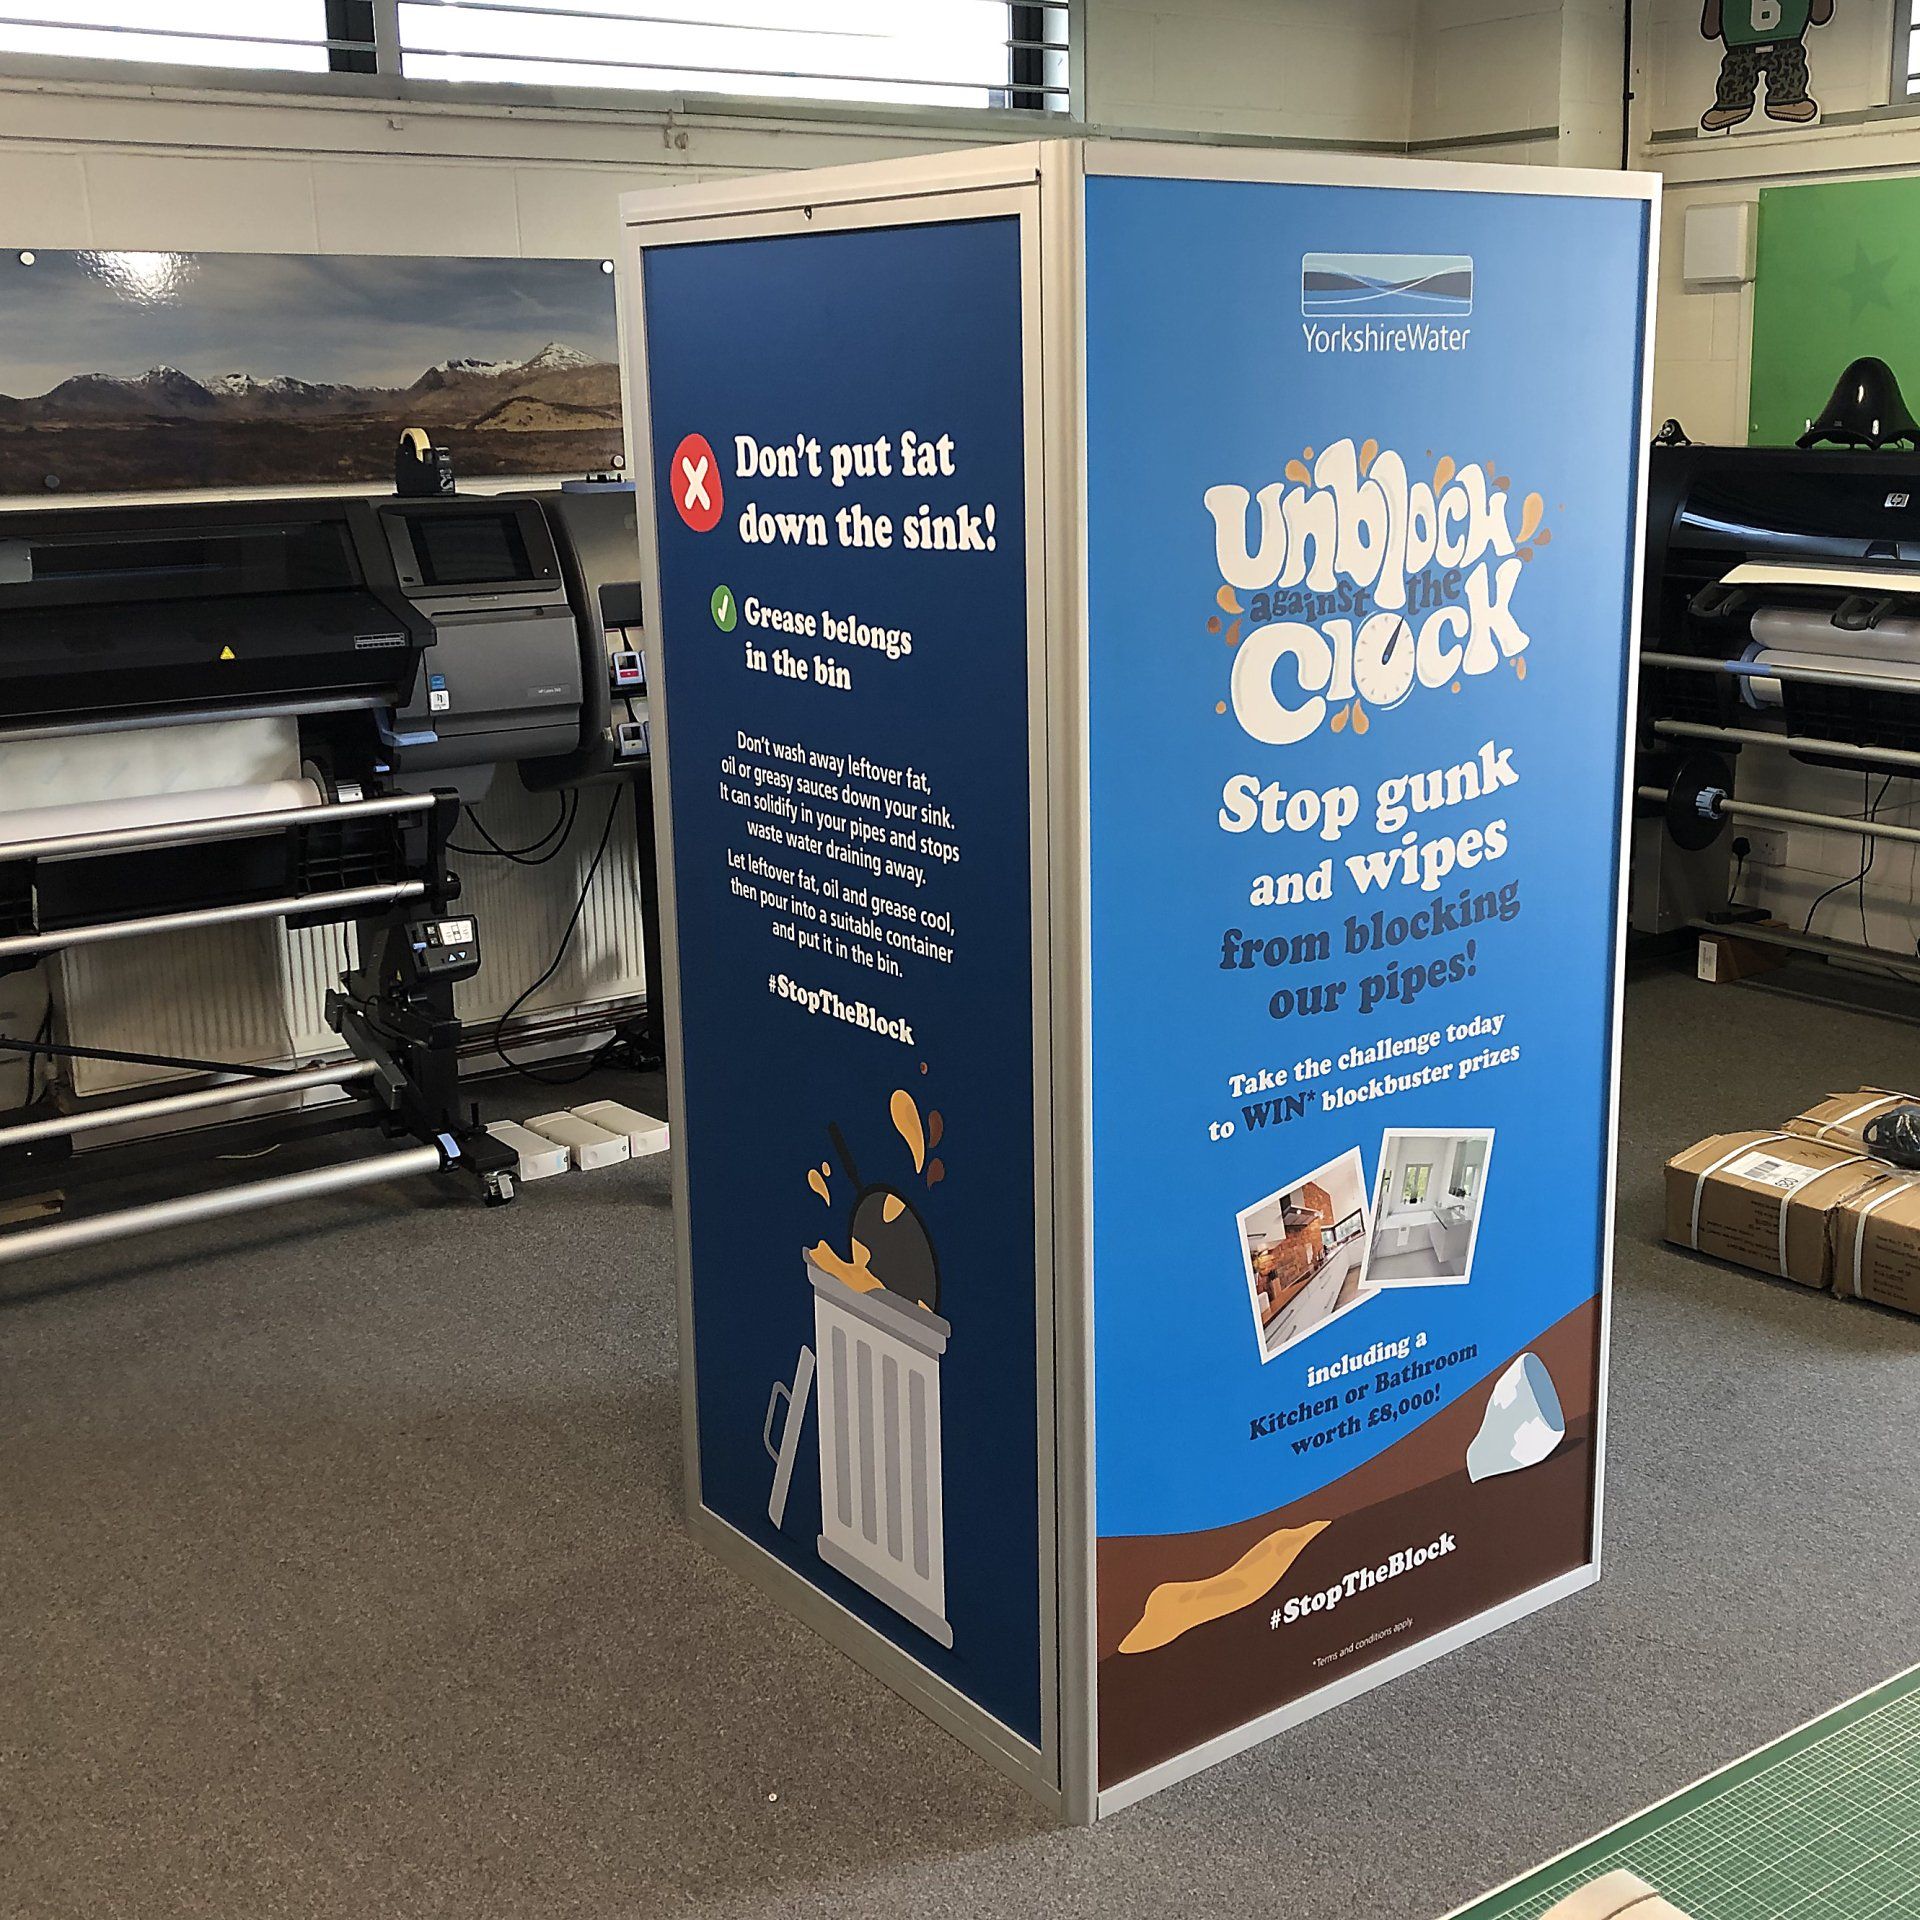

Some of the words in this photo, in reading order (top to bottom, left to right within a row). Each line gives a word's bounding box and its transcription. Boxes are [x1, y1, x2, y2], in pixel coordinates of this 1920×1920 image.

[1750, 0, 1781, 31] 6
[1302, 323, 1471, 353] YorkshireWater
[734, 433, 822, 477] Don't
[830, 436, 892, 487] put
[901, 430, 955, 477] fat
[739, 503, 828, 546] down
[836, 504, 892, 548] the
[903, 503, 996, 551] sink!
[744, 597, 816, 636] Grease
[822, 611, 912, 660] belongs
[1250, 580, 1371, 623] against
[1404, 569, 1462, 615] the
[745, 642, 767, 671] in
[772, 649, 808, 680] the
[813, 655, 852, 690] bin
[721, 755, 736, 774] oil
[738, 762, 751, 778] or
[754, 768, 793, 793] greasy
[796, 777, 838, 800] sauces
[842, 784, 880, 812] down
[884, 797, 917, 819] your
[921, 804, 955, 829] sink.
[737, 730, 770, 755] Don't
[773, 743, 805, 764] wash
[809, 752, 844, 777] away
[848, 754, 902, 785] leftover
[906, 767, 931, 795] fat,
[1218, 774, 1359, 841] Stop
[1376, 740, 1520, 834] gunk
[719, 782, 729, 800] It
[731, 788, 751, 806] can
[754, 793, 798, 823] solidify
[801, 802, 813, 822] in
[816, 810, 847, 832] your
[850, 817, 886, 844] pipes
[890, 830, 916, 851] and
[920, 836, 960, 864] stops
[747, 820, 783, 843] waste
[786, 831, 823, 855] water
[826, 839, 881, 875] draining
[885, 859, 926, 888] away.
[728, 848, 745, 871] Let
[748, 852, 795, 884] leftover
[797, 868, 819, 895] fat,
[823, 878, 838, 899] oil
[843, 886, 867, 908] and
[871, 895, 916, 922] grease
[920, 910, 955, 936] cool,
[1249, 858, 1333, 907] and
[1345, 819, 1508, 893] wipes
[731, 876, 757, 900] then
[760, 887, 788, 912] pour
[791, 895, 816, 919] into
[820, 908, 827, 923] a
[831, 909, 882, 941] suitable
[886, 928, 953, 964] container
[772, 920, 795, 941] and
[798, 928, 820, 949] put
[823, 937, 832, 953] it
[836, 940, 848, 960] in
[851, 943, 874, 968] the
[877, 950, 903, 977] bin.
[1219, 928, 1331, 969] from
[1344, 880, 1520, 954] blocking
[768, 973, 914, 1045] #StopTheBlock
[1269, 979, 1347, 1019] our
[1359, 939, 1476, 1014] pipes!
[1228, 1068, 1288, 1097] Take
[1294, 1057, 1332, 1083] the
[1337, 1029, 1441, 1069] challenge
[1446, 1013, 1506, 1043] today
[1208, 1119, 1235, 1142] to
[1321, 1063, 1454, 1112] blockbuster
[1458, 1044, 1520, 1080] prizes
[1249, 1395, 1339, 1440] Kitchen
[1344, 1383, 1370, 1405] or
[1374, 1343, 1478, 1395] Bathroom
[1306, 1336, 1411, 1388] including
[1415, 1331, 1428, 1348] a
[1291, 1416, 1361, 1455] worth
[1367, 1383, 1441, 1428] £8,000!
[1269, 1532, 1457, 1630] #StopTheBlock
[1339, 1643, 1354, 1657] and
[1355, 1627, 1392, 1650] conditions
